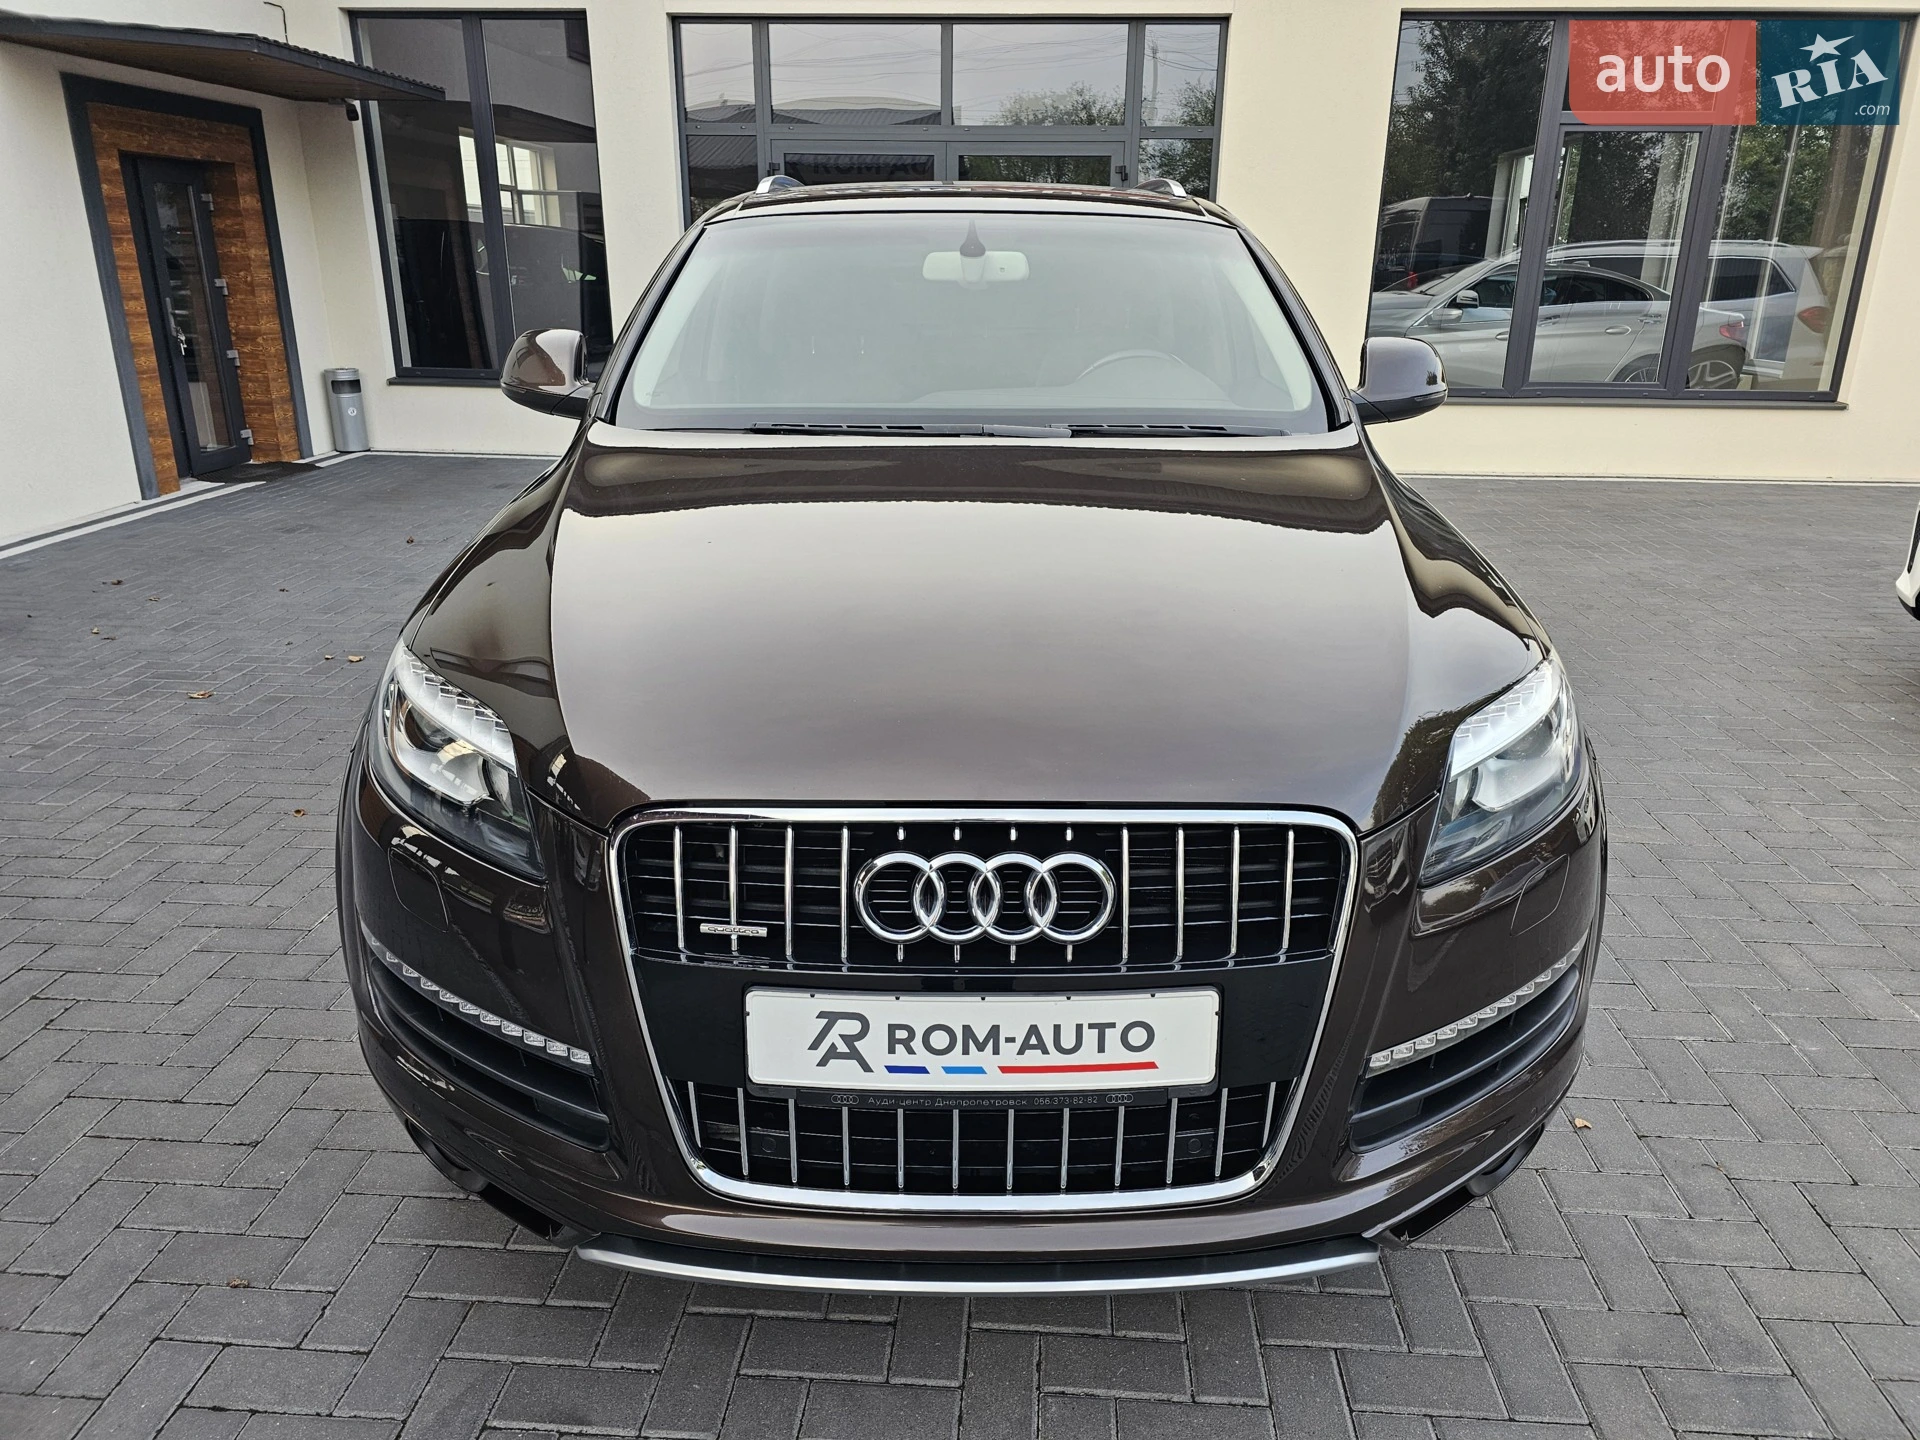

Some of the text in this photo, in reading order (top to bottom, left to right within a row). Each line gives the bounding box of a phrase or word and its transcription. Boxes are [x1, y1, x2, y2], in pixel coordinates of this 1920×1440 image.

[706, 925, 760, 935] quattro
[886, 1020, 1156, 1056] ROM-AUTO
[934, 1097, 1028, 1107] Днепропетровск
